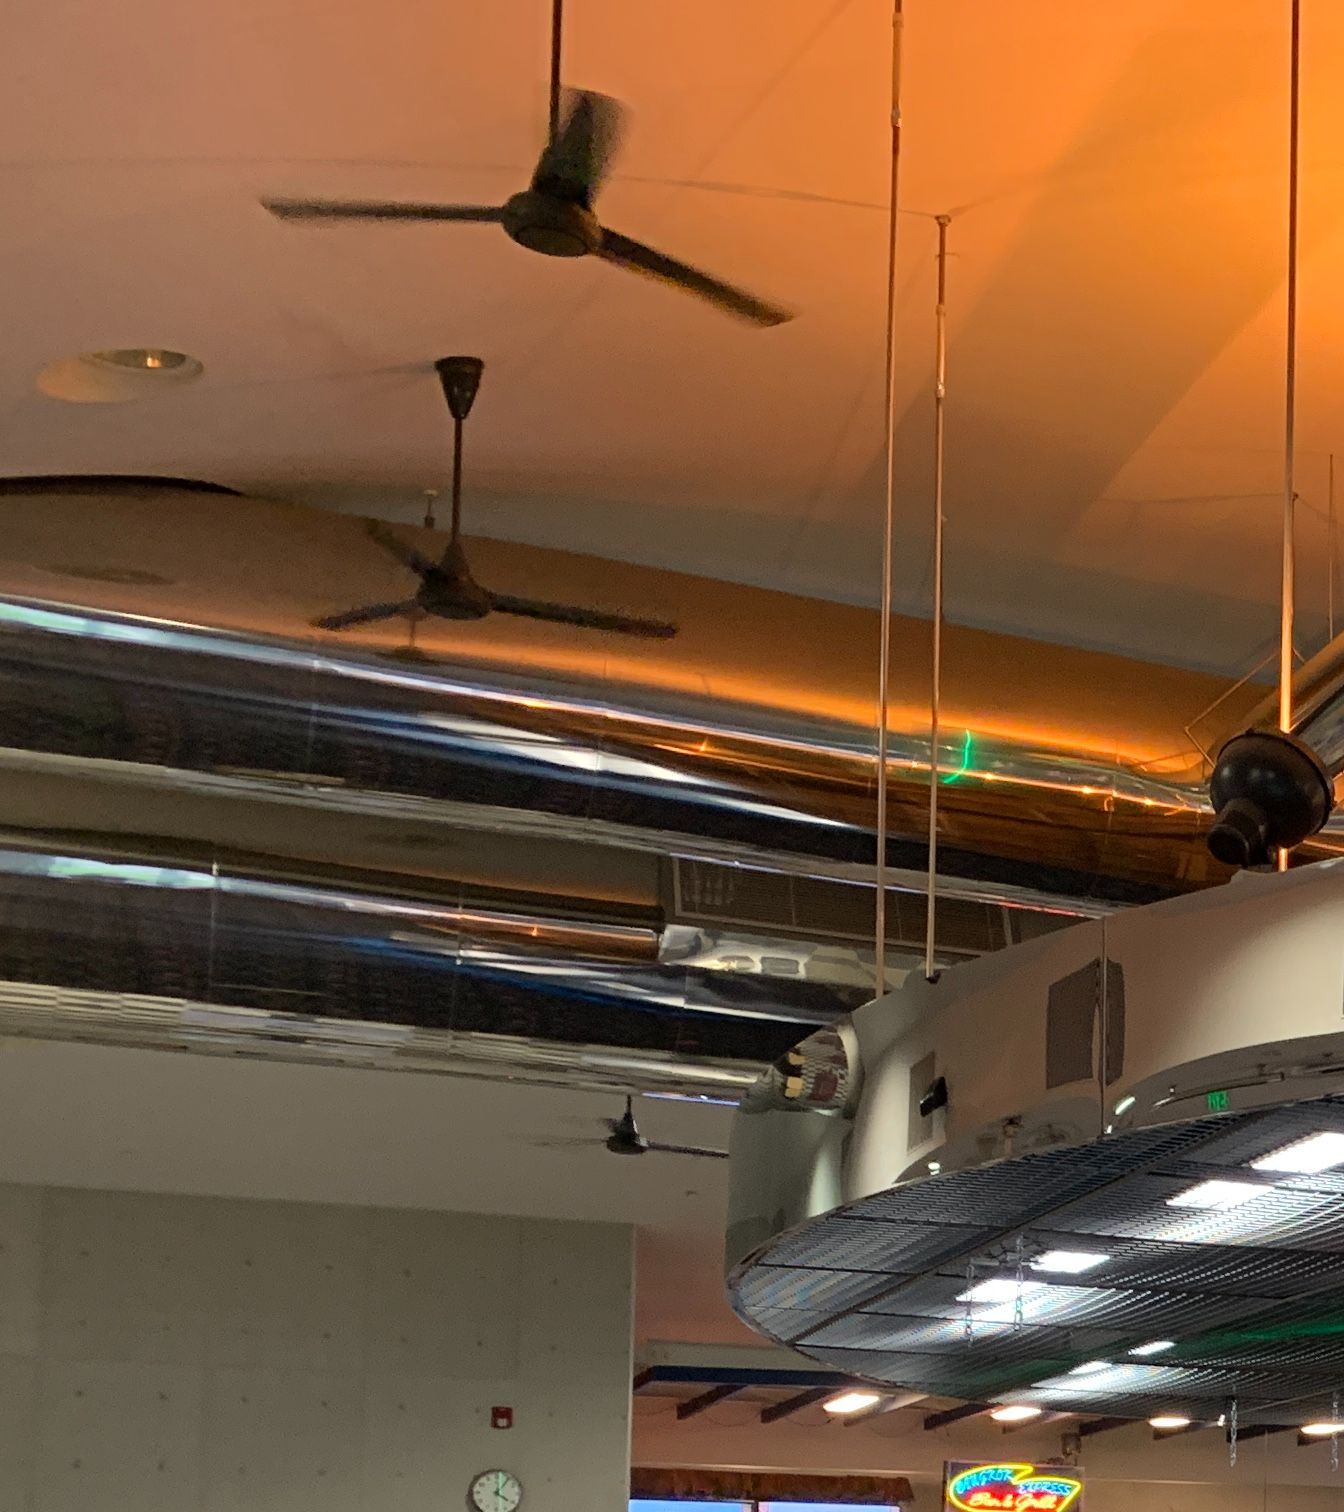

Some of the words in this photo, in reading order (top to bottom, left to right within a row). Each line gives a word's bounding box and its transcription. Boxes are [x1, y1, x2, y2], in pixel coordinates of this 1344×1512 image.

[956, 1468, 1013, 1495] BANGKOK
[1018, 1481, 1072, 1496] EXPRESS
[1015, 1493, 1057, 1512] Grill
